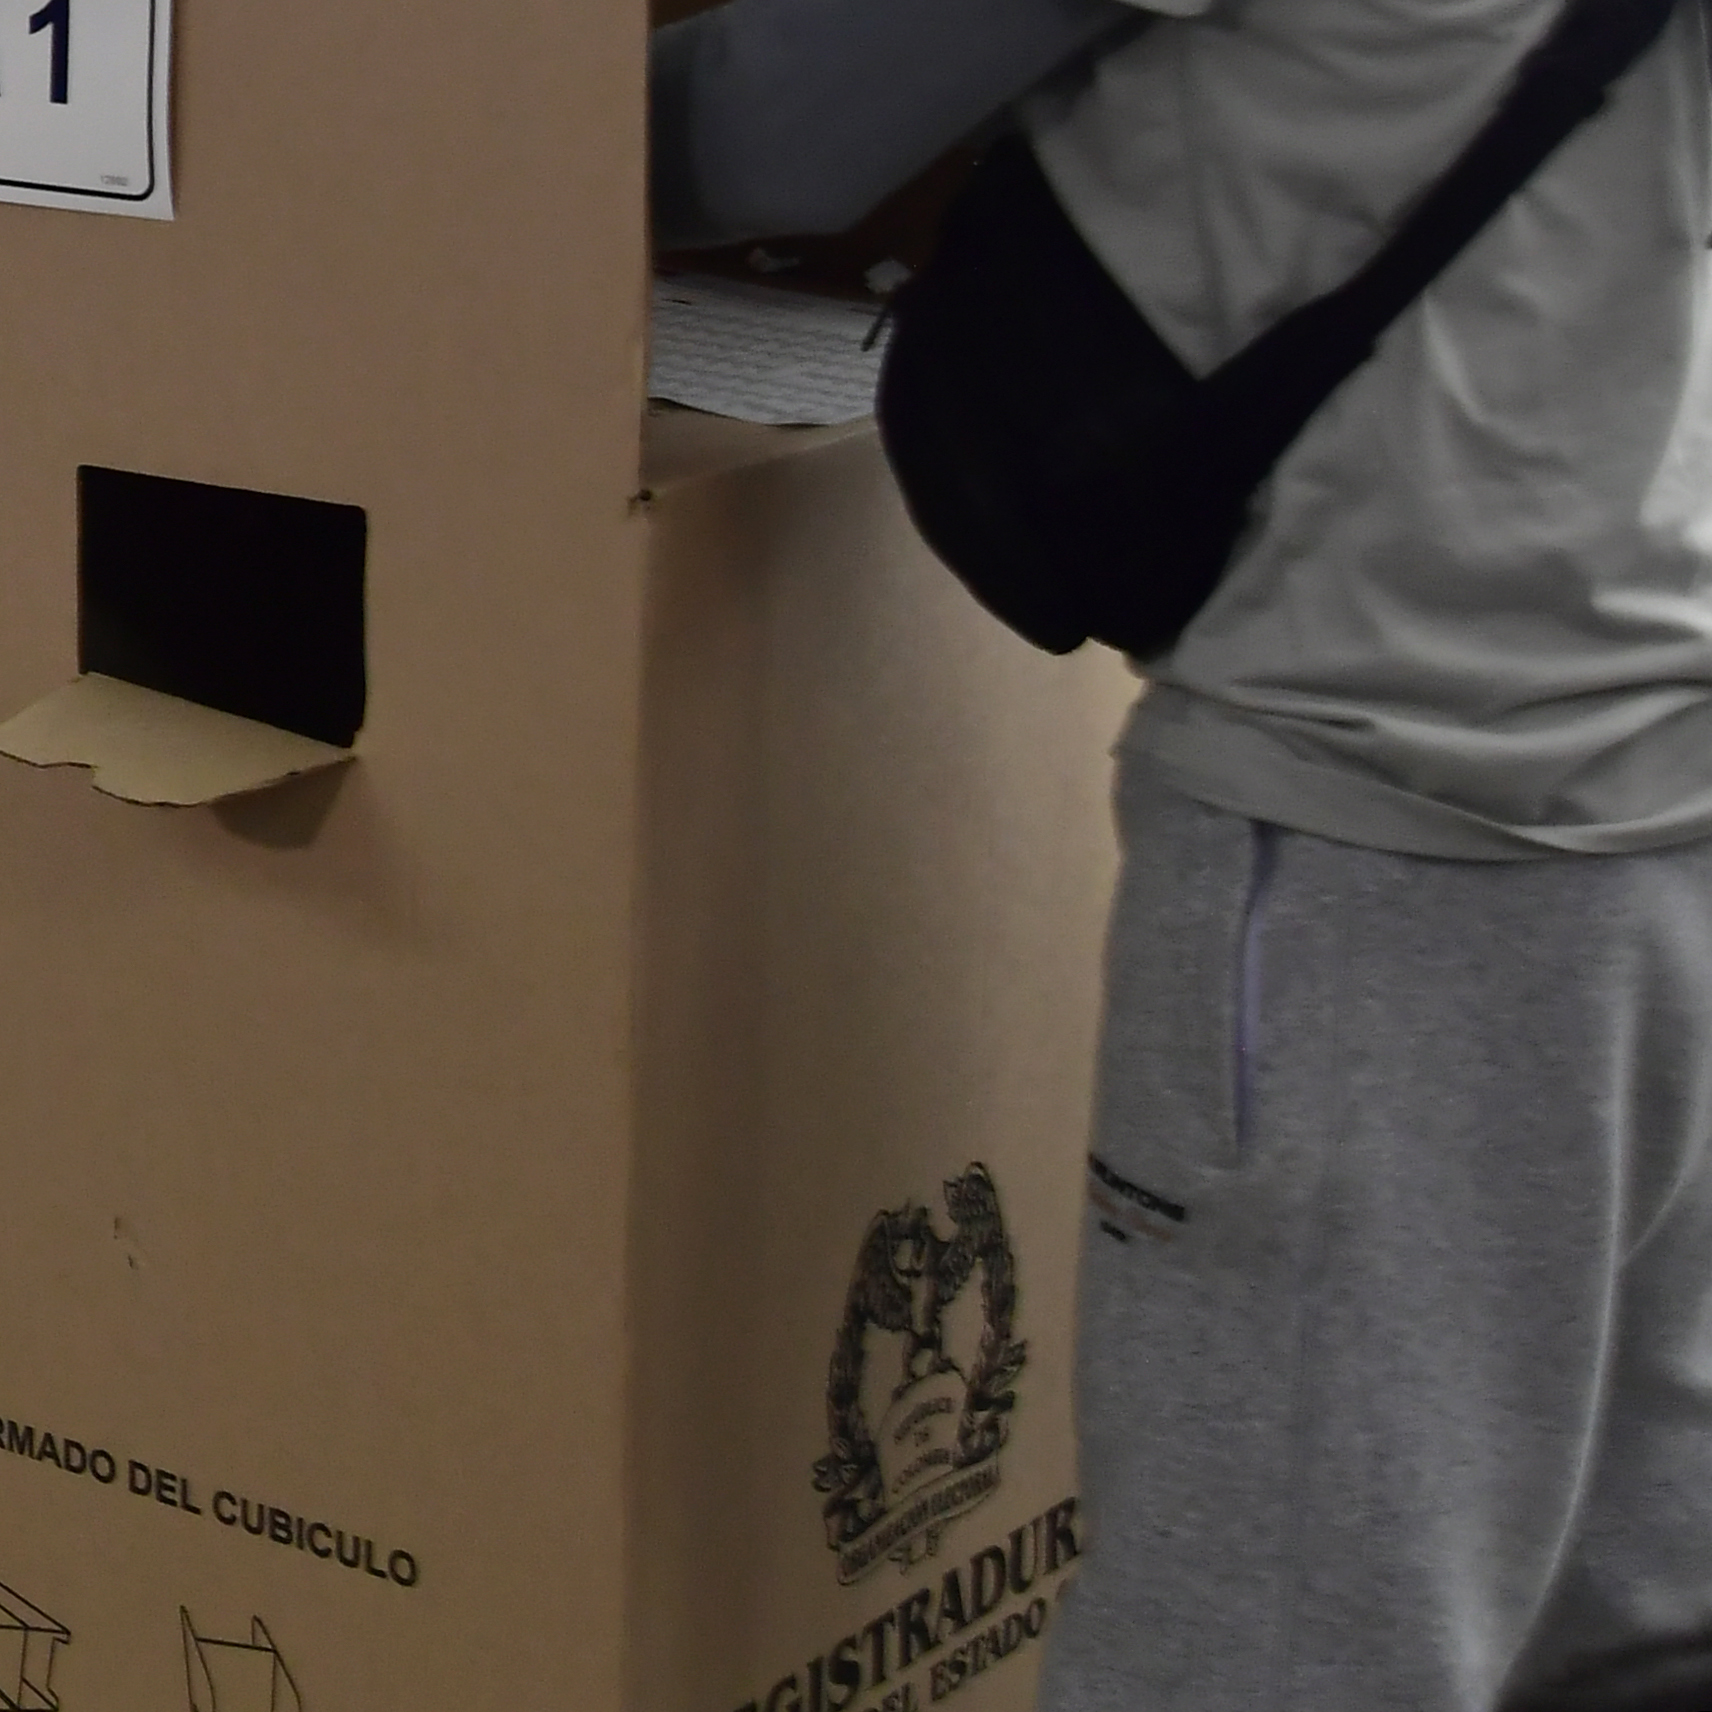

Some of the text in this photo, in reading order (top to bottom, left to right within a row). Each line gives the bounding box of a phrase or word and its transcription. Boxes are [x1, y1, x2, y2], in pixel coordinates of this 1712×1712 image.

[128, 1459, 203, 1516] DEL
[212, 1490, 418, 1588] CUBICULO
[733, 1496, 1080, 1712] GISTRADUR
[930, 1597, 1047, 1703] ESTADO
